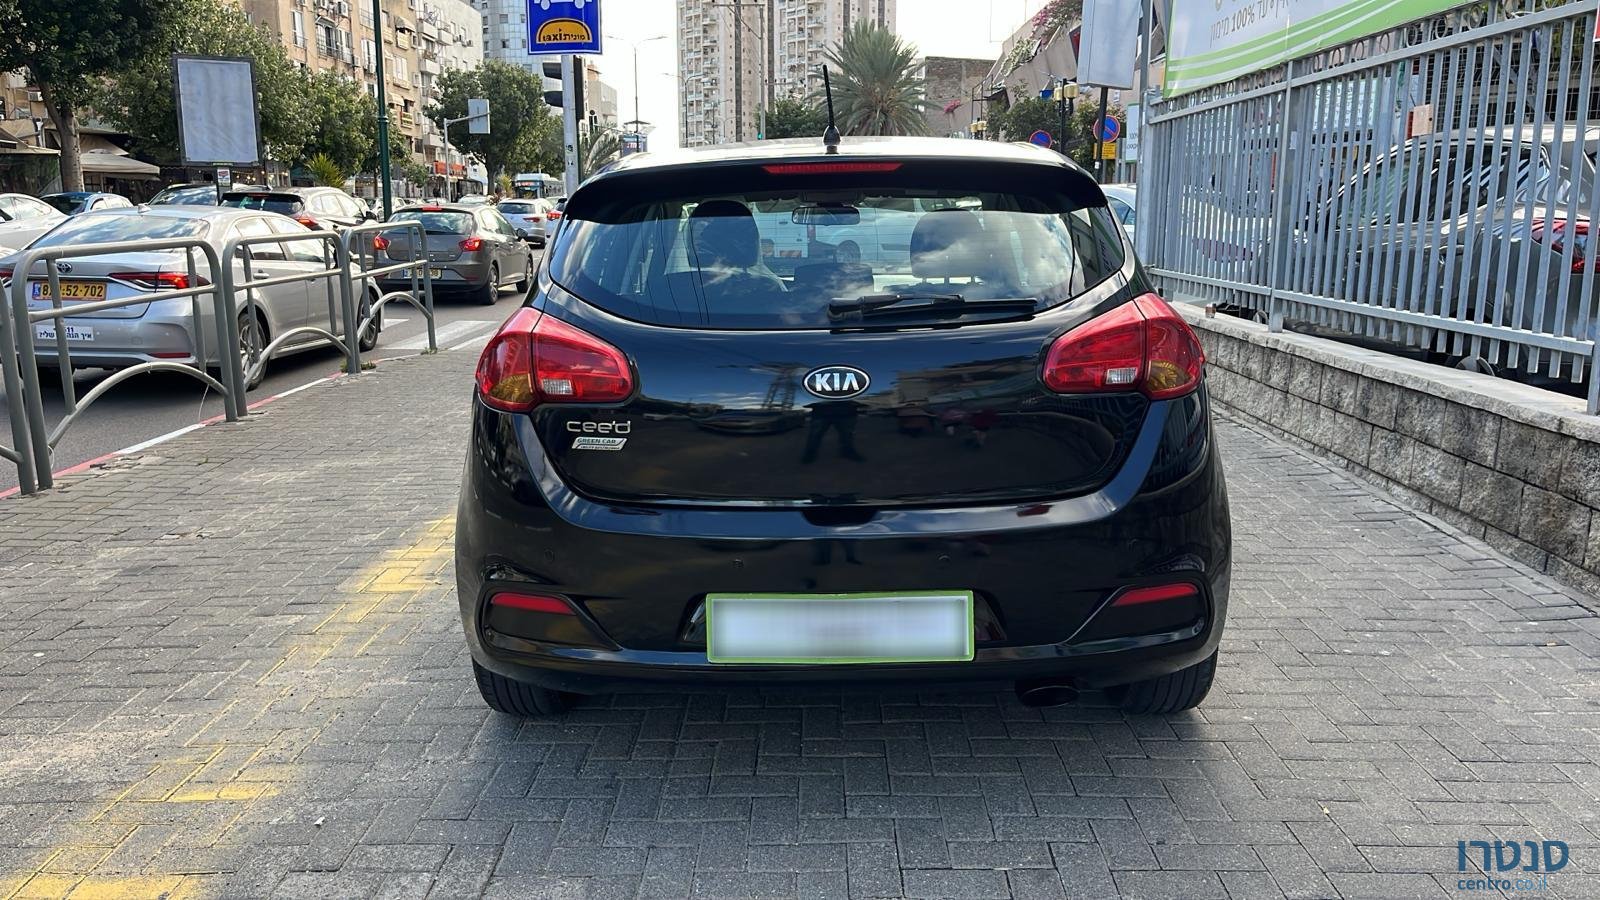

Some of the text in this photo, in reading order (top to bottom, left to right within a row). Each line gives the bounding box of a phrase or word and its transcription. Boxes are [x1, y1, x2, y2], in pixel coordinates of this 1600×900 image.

[1231, 4, 1255, 32] 100%
[1209, 16, 1231, 49] מימון
[815, 372, 860, 392] KIA
[566, 420, 631, 434] cee'd
